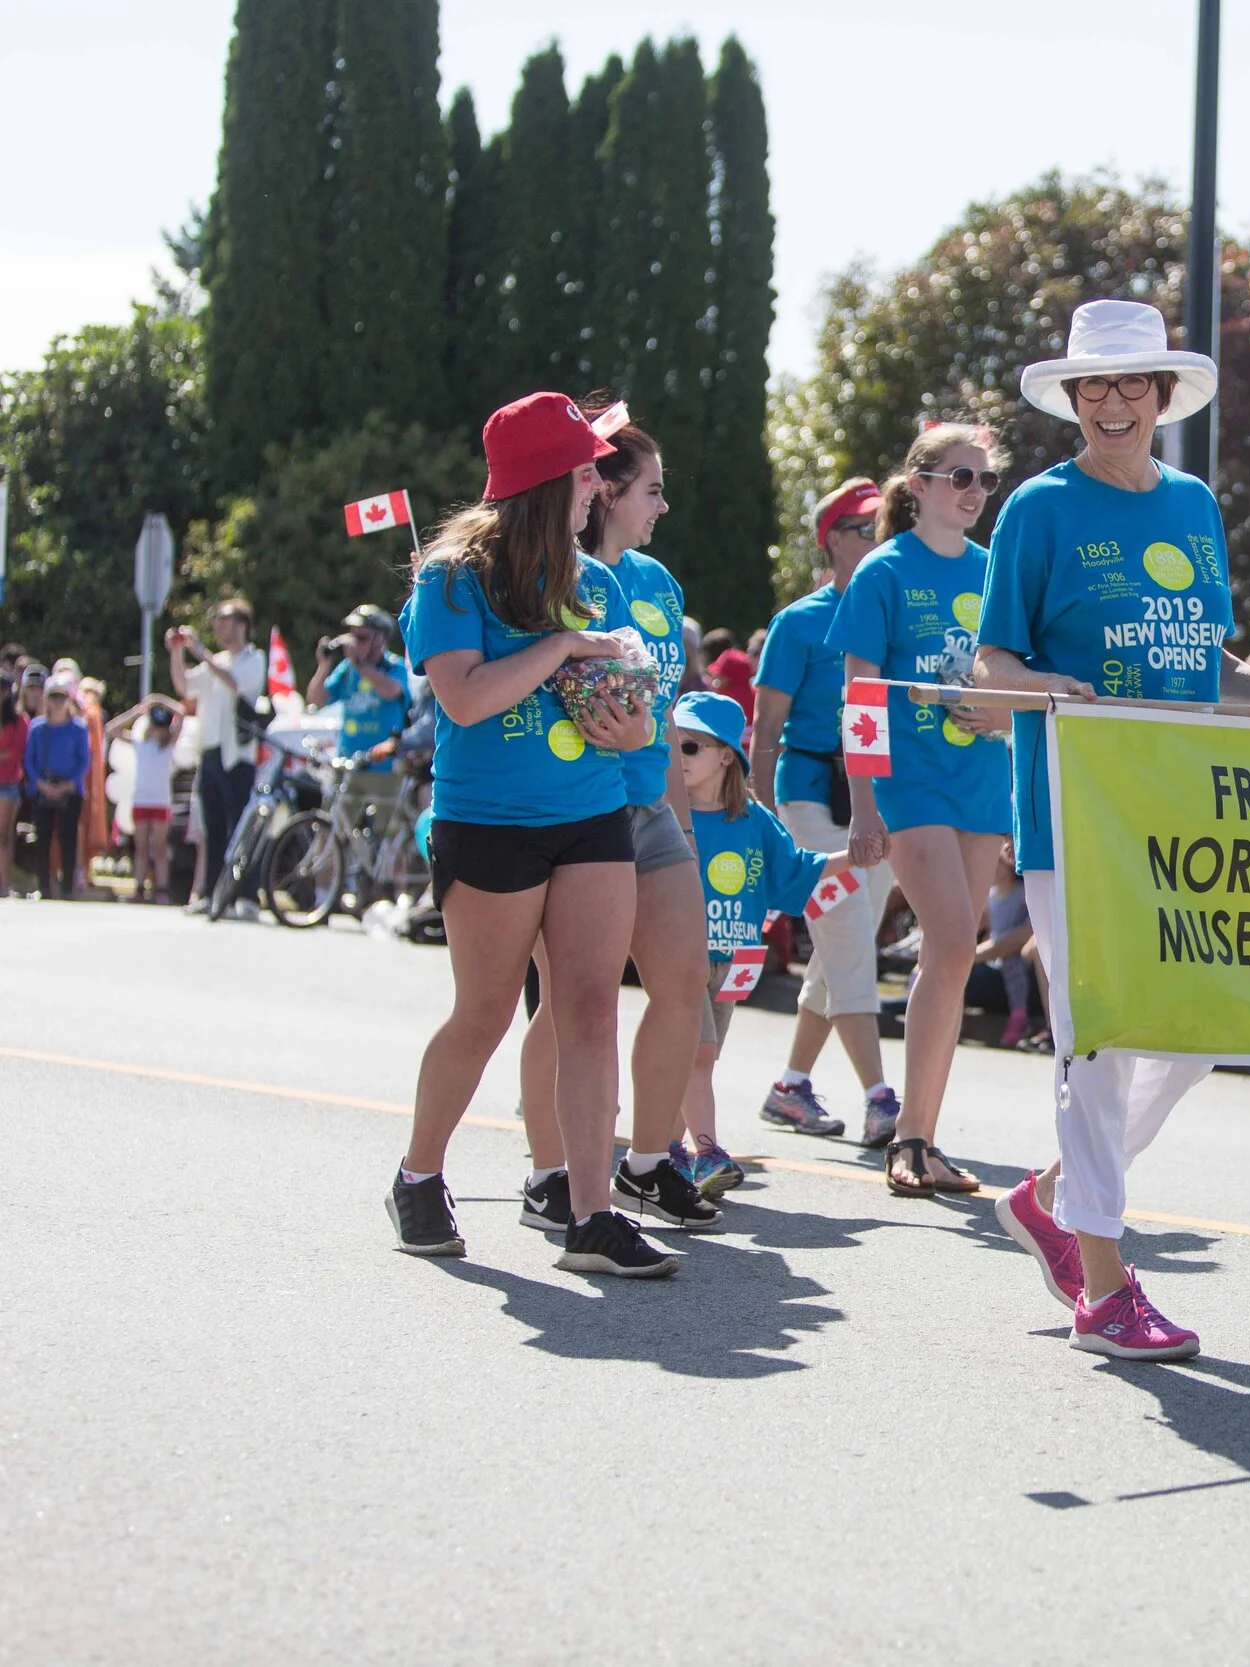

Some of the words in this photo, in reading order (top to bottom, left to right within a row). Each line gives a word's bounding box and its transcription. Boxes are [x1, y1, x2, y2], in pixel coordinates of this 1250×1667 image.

[1077, 541, 1120, 560] 1863
[1147, 550, 1186, 565] 1882
[1082, 556, 1125, 568] Moodyville
[1202, 544, 1224, 587] 1900
[1102, 572, 1126, 582] 1906
[904, 589, 937, 601] 1863
[920, 613, 939, 622] 1906
[1141, 596, 1204, 621] 2019
[1103, 622, 1155, 650] NEW
[646, 641, 680, 663] 019
[1147, 646, 1207, 672] OPENS
[1103, 659, 1124, 695] 40
[1171, 677, 1185, 688] 1977
[525, 706, 534, 733] Victory
[707, 899, 743, 920] 019
[708, 920, 759, 941] MUSEUM
